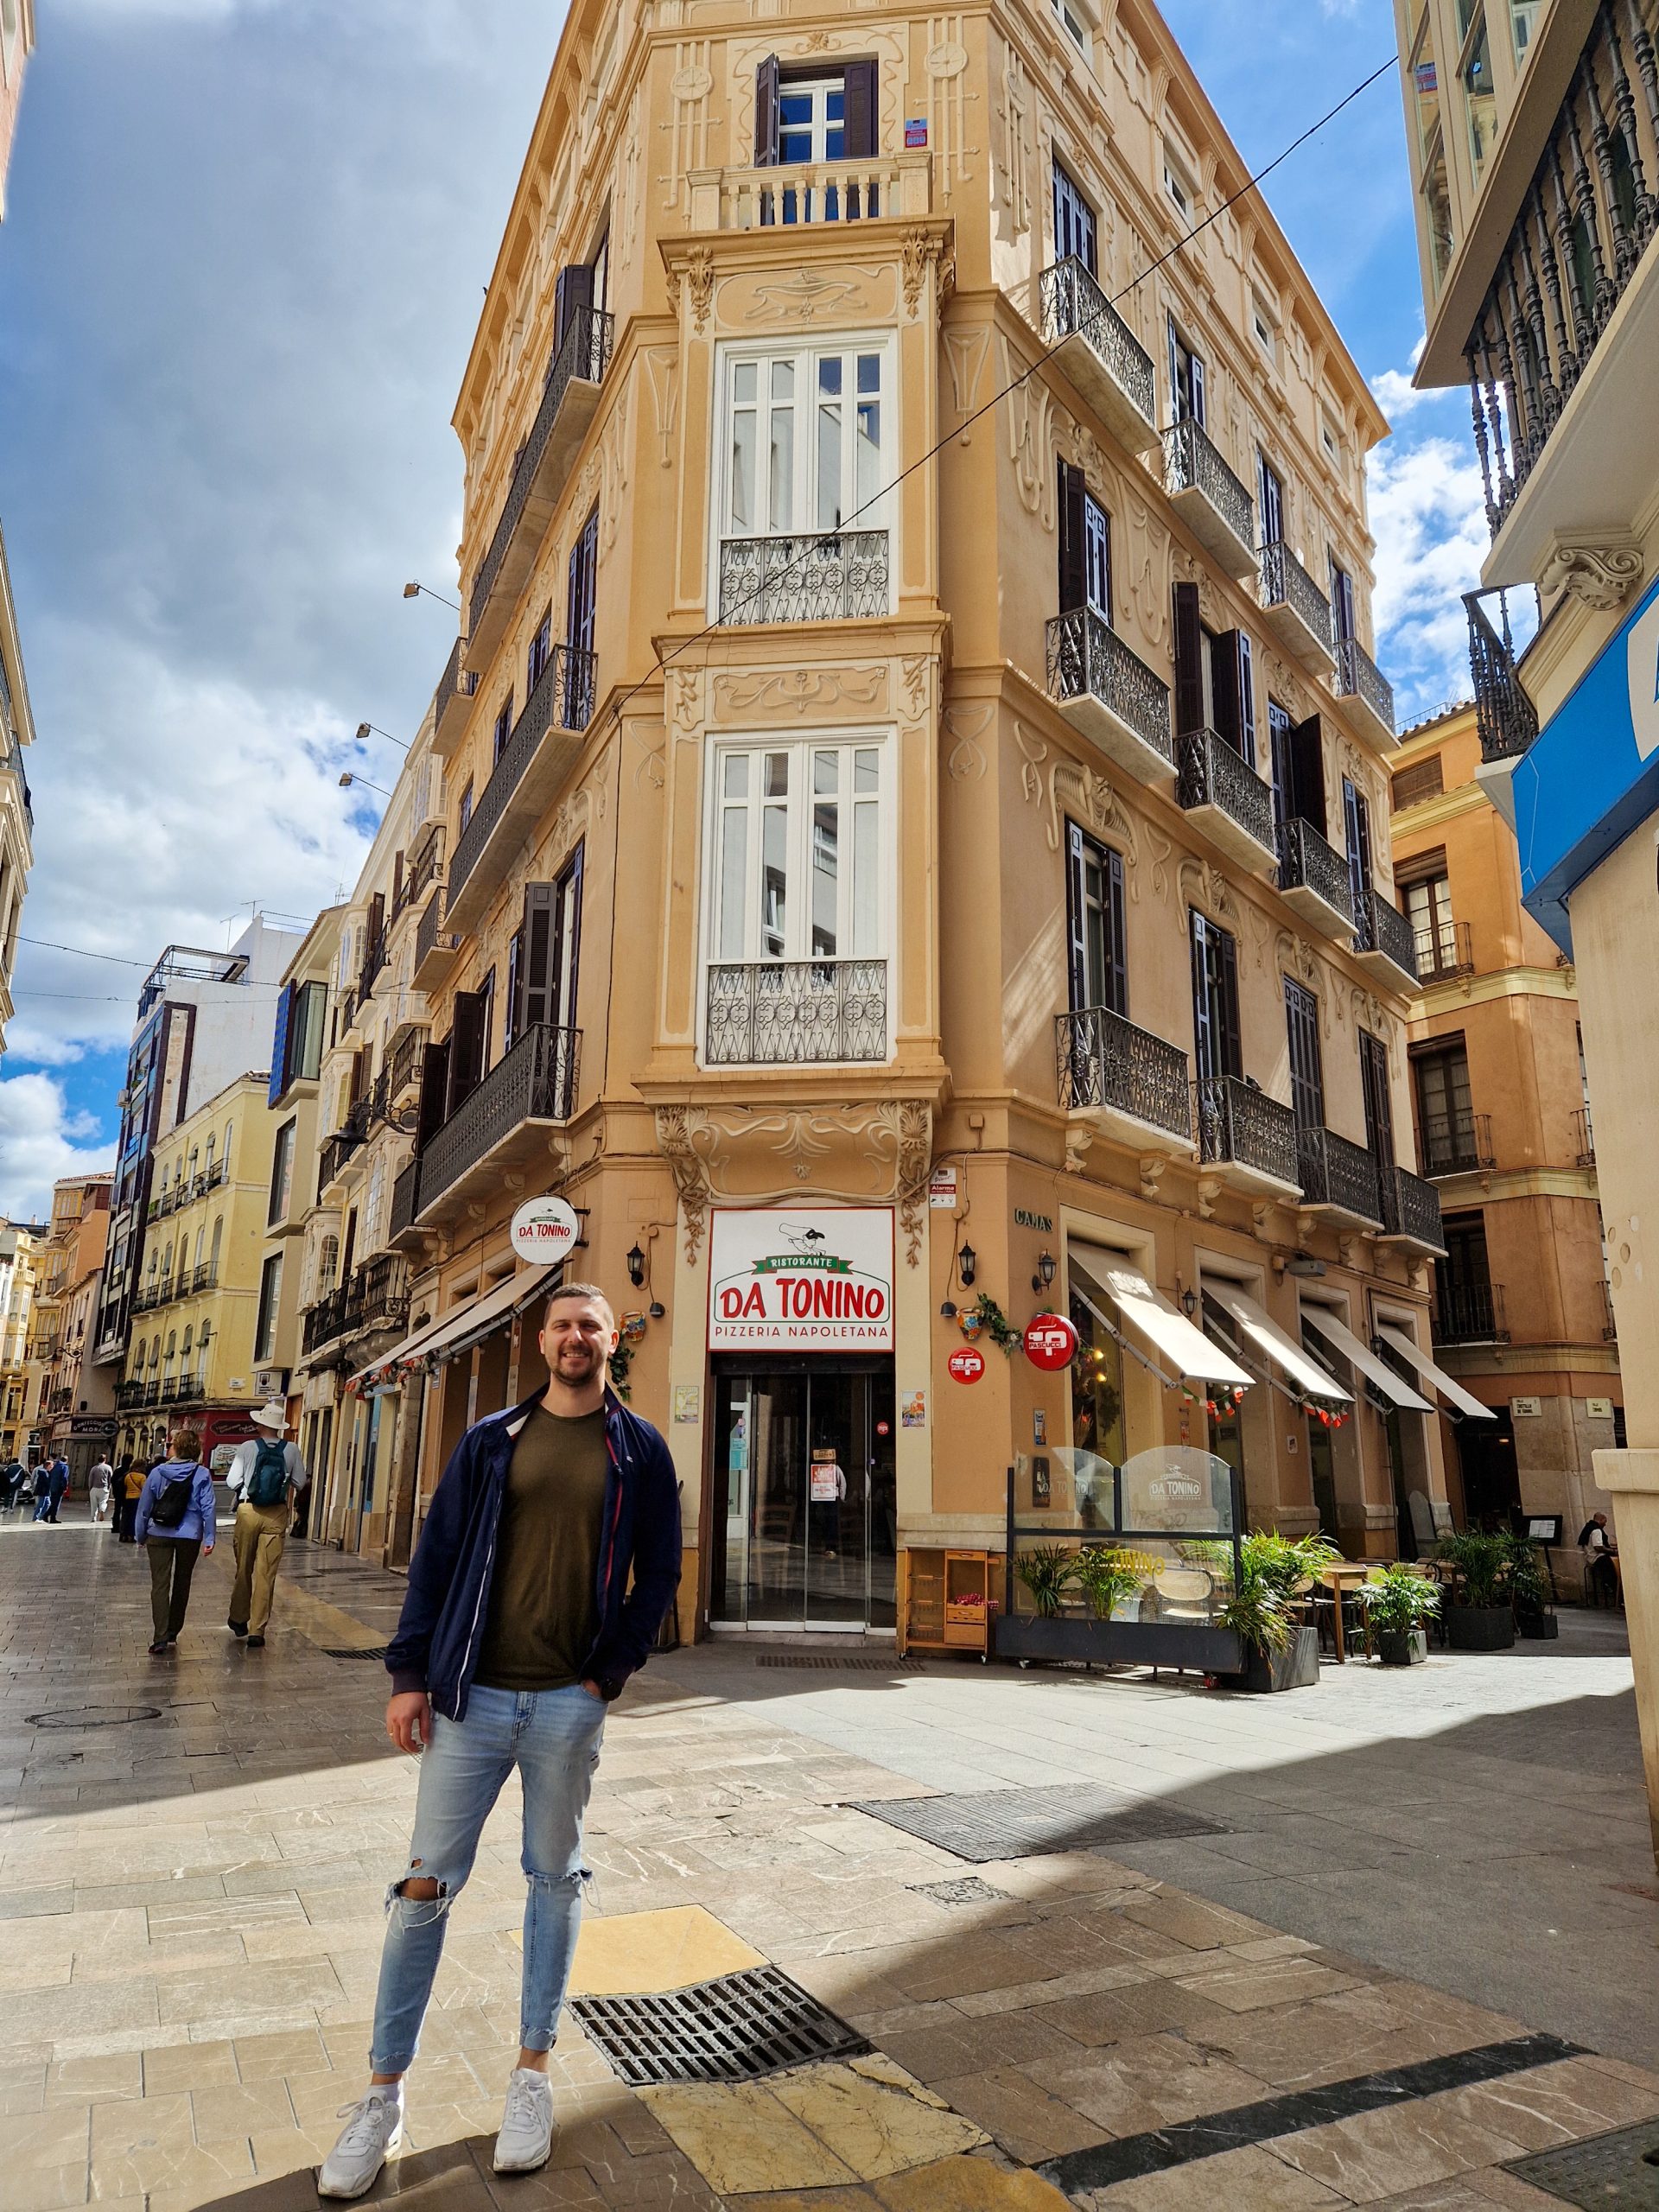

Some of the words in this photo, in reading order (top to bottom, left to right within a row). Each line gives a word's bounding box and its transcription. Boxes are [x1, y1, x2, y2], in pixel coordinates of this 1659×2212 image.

[518, 1225, 533, 1237] DA
[537, 1224, 570, 1237] TONINO
[770, 1256, 833, 1268] RISTORANTE
[720, 1281, 767, 1319] DA
[776, 1278, 885, 1319] TONINO
[715, 1326, 781, 1338] PIZZERIA
[788, 1326, 889, 1338] NAPOLETANA
[1151, 1483, 1165, 1494] DA
[1166, 1481, 1199, 1495] TONINO
